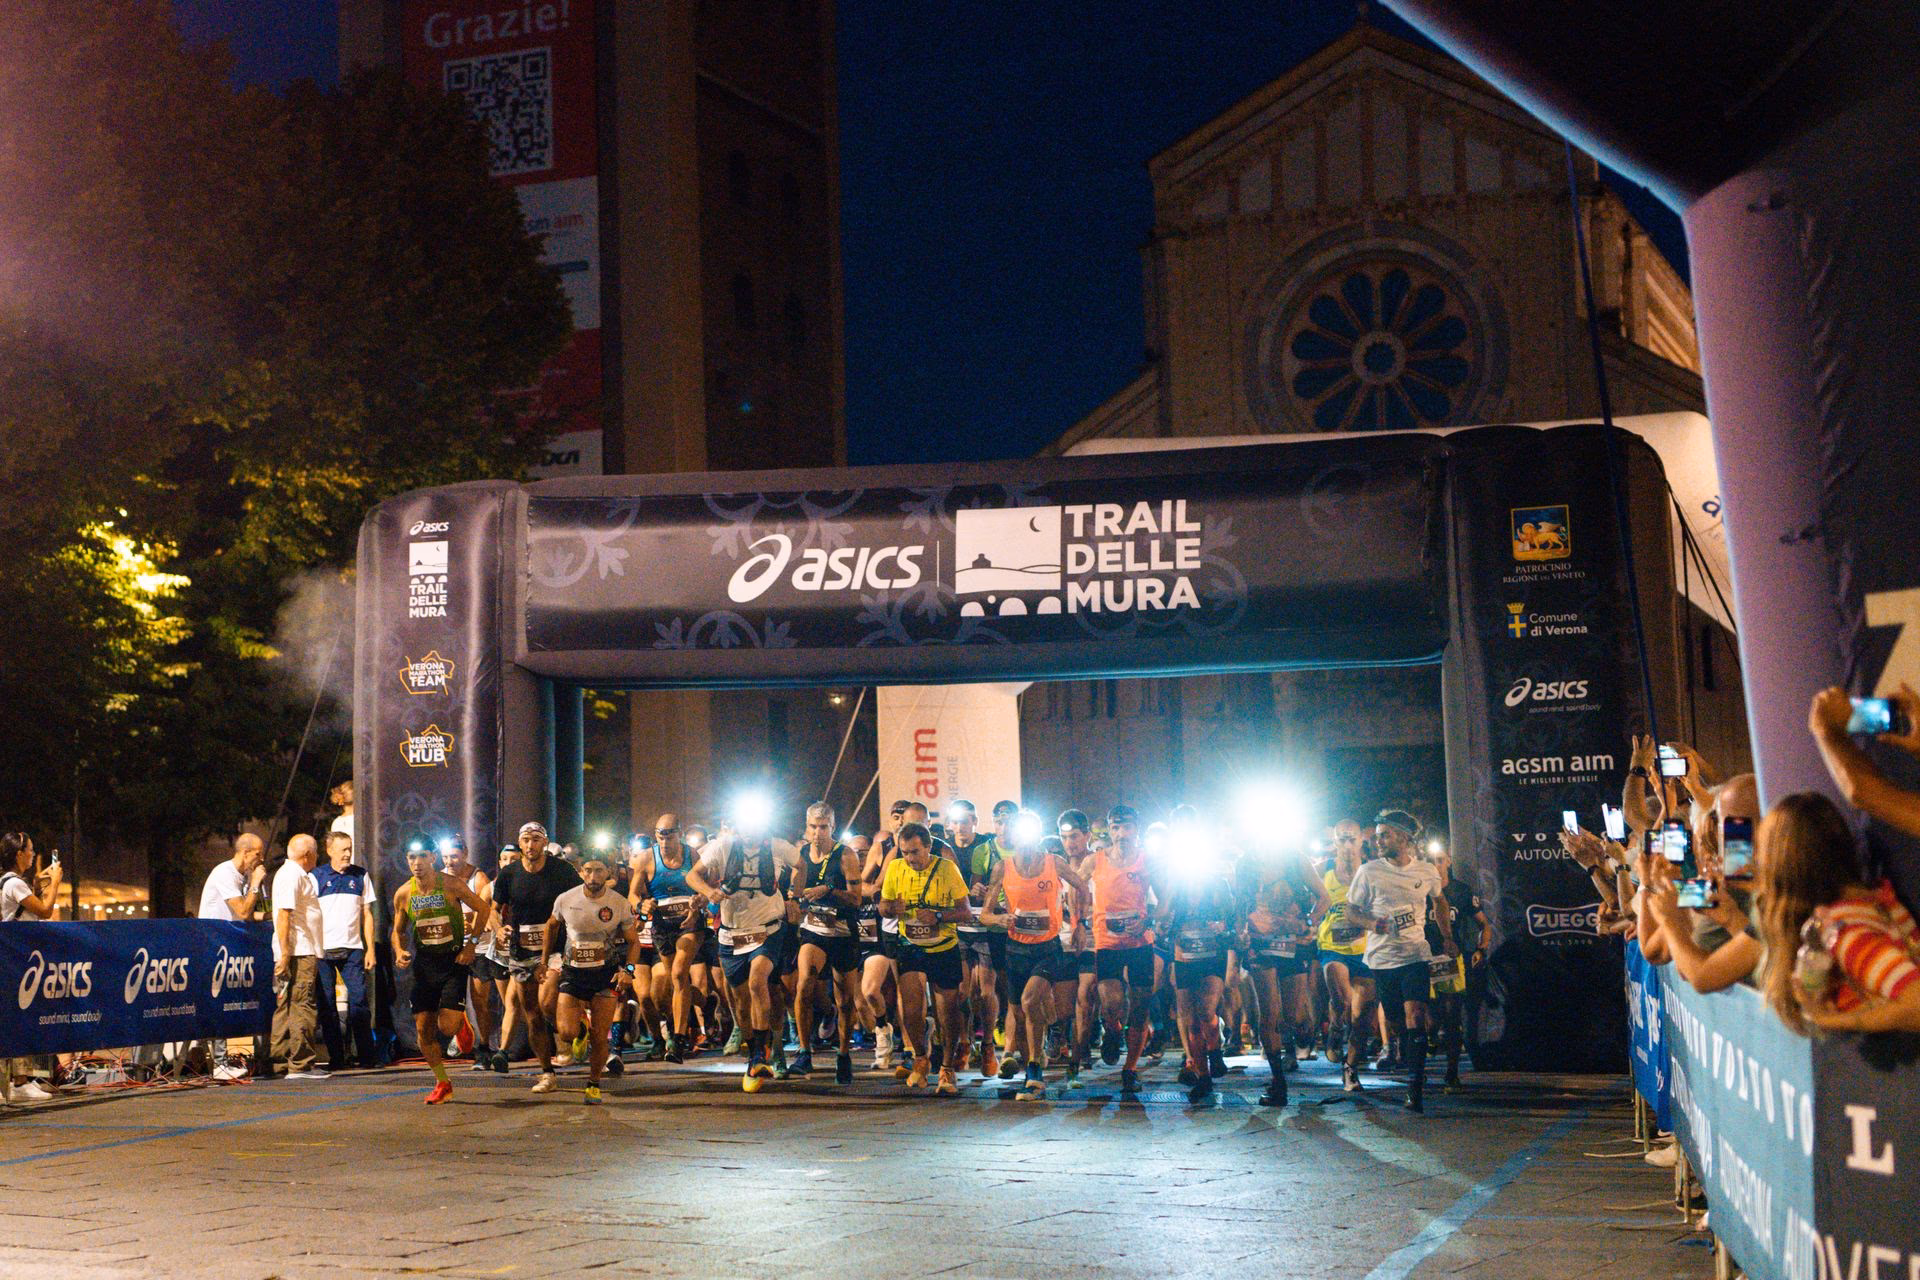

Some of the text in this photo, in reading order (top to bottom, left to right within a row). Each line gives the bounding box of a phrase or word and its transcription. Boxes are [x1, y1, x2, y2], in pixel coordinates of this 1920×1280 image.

[424, 0, 571, 48] Grazie!
[1065, 500, 1201, 537] TRAIL
[423, 521, 449, 533] asics
[1067, 538, 1201, 574] DELLE
[792, 545, 924, 590] asics
[1515, 562, 1571, 574] PATROCINIO
[409, 583, 447, 595] TRAIL
[1067, 577, 1201, 613] MURA
[409, 595, 447, 606] DELLE
[409, 606, 447, 618] MURA
[1529, 612, 1578, 624] Comune
[1530, 624, 1588, 637] di Verona
[409, 662, 445, 671] VERONA
[410, 675, 445, 687] TEAM
[1531, 680, 1588, 700] asics
[409, 736, 444, 745] VERONA
[409, 749, 444, 763] HUB
[914, 728, 939, 799] aim
[1570, 754, 1614, 771] aim
[1533, 912, 1598, 928] ZUEGG
[146, 957, 189, 993] asics
[226, 955, 254, 988] asics
[43, 961, 92, 999] asics
